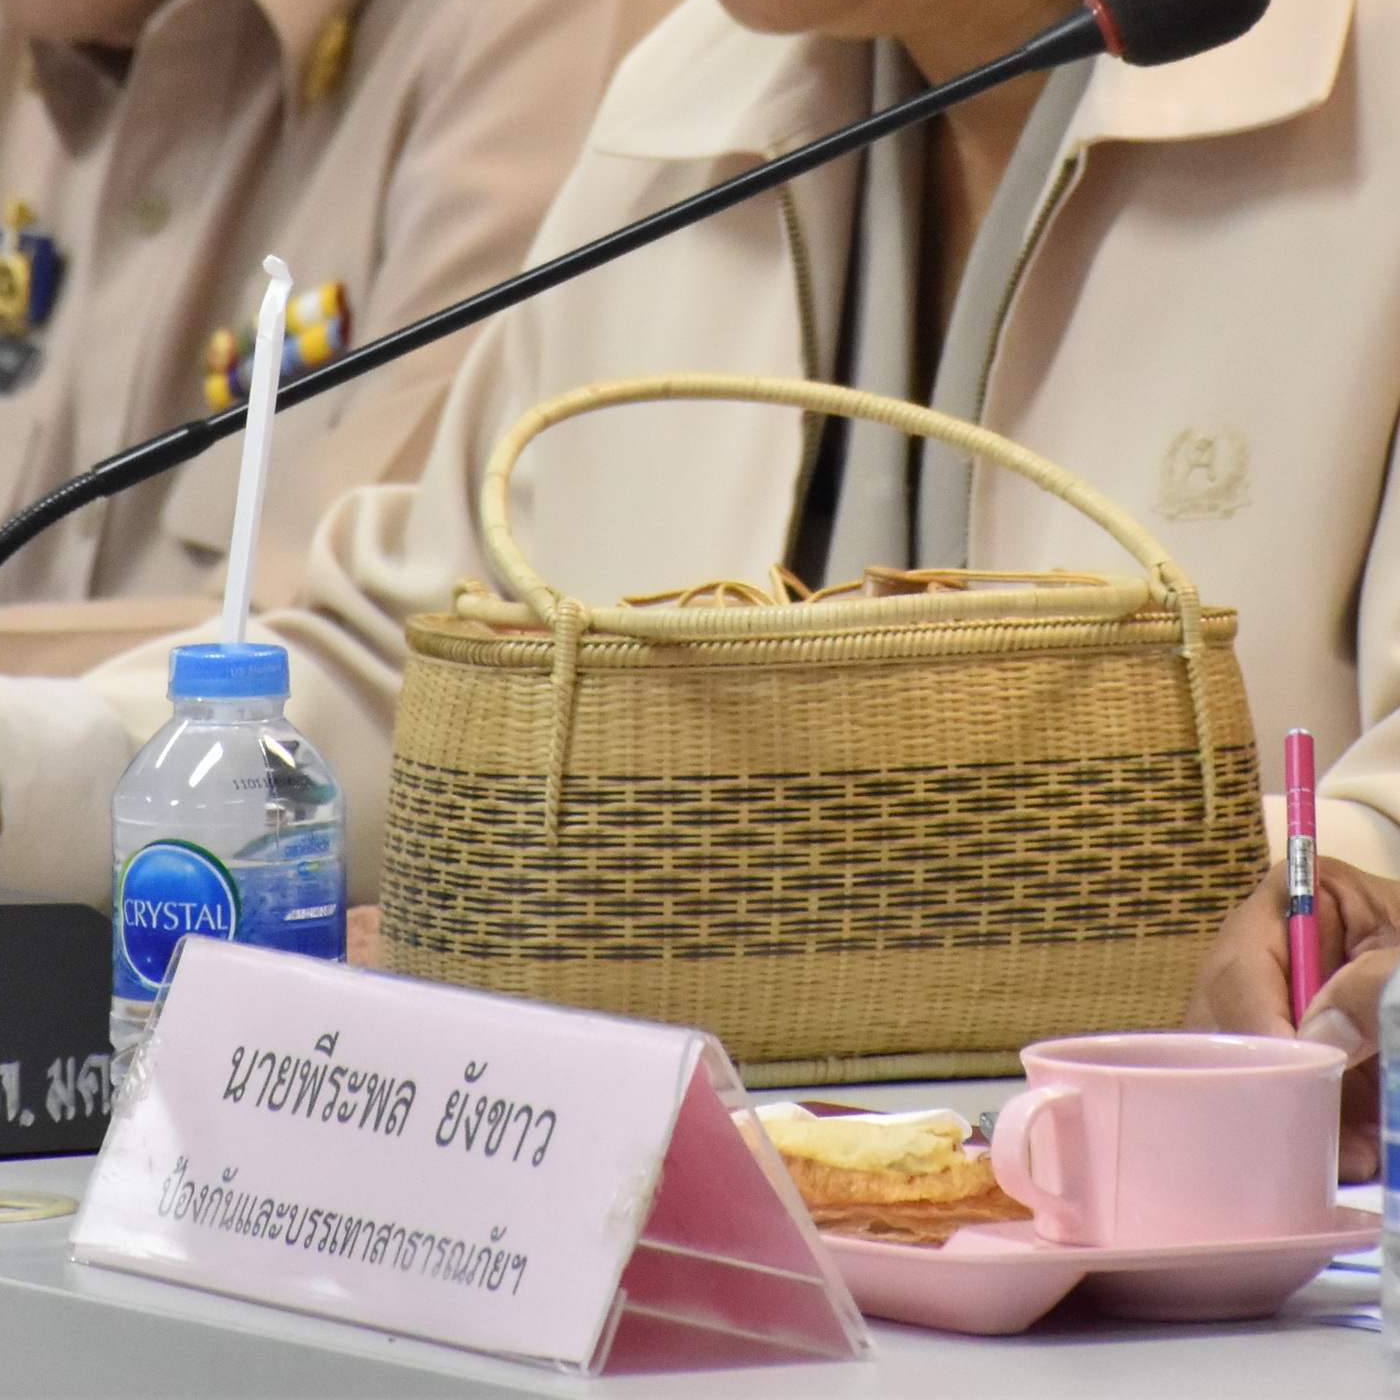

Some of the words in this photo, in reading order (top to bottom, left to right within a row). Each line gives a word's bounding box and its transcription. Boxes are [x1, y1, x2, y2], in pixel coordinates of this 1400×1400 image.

[124, 898, 229, 932] CRYSTAL
[222, 1031, 418, 1137] นายพีระพล
[435, 1061, 558, 1167] ยังขาว
[157, 1156, 528, 1296] ป้องกันและบรรเทาสาธารณภัยฯ
